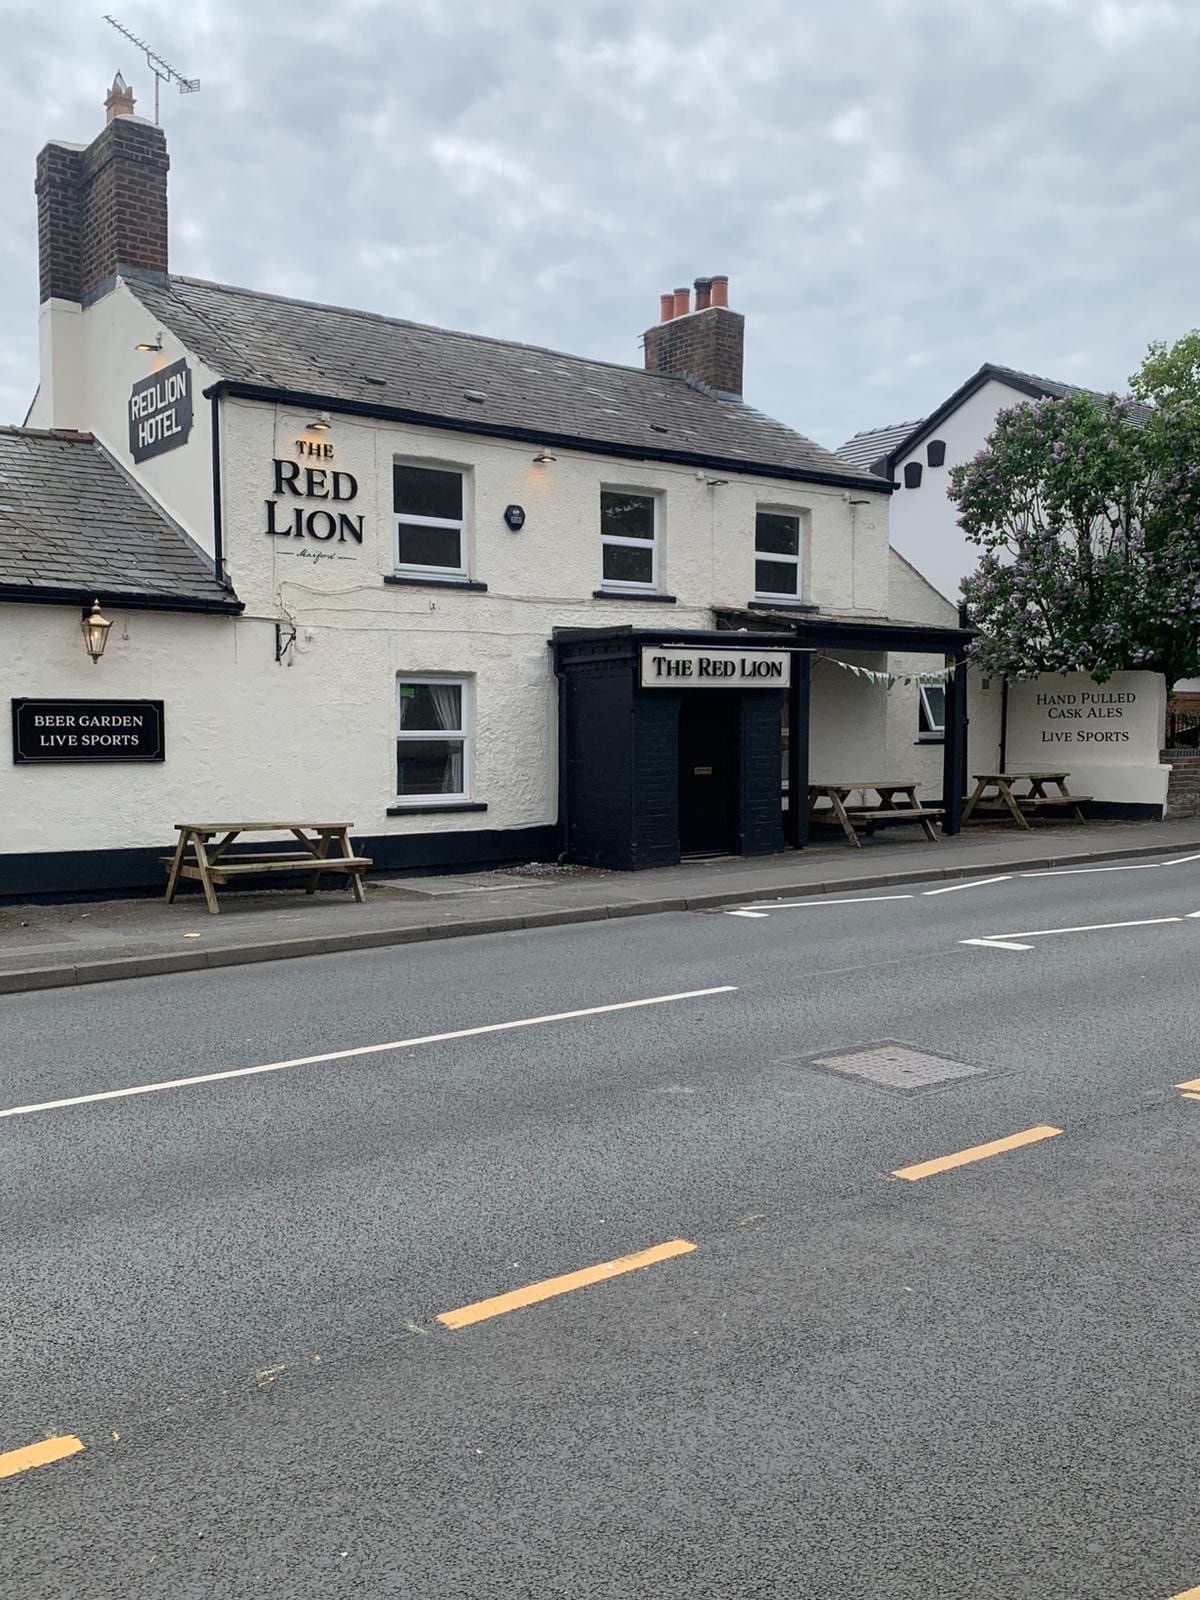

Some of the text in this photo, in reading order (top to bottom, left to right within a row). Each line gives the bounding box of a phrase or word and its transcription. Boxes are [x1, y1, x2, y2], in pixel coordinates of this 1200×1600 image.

[138, 408, 182, 448] HOTEL
[295, 440, 334, 459] THE
[272, 458, 358, 501] RED
[264, 499, 366, 544] LION
[652, 656, 782, 678] THE RED LION
[1036, 692, 1136, 705] HAND PULLED
[34, 715, 143, 727] BEER GARDEN
[1048, 707, 1123, 719] CASK ALES
[40, 734, 140, 746] LIVE SPORTS
[1041, 730, 1130, 742] LIVE SPORTS
